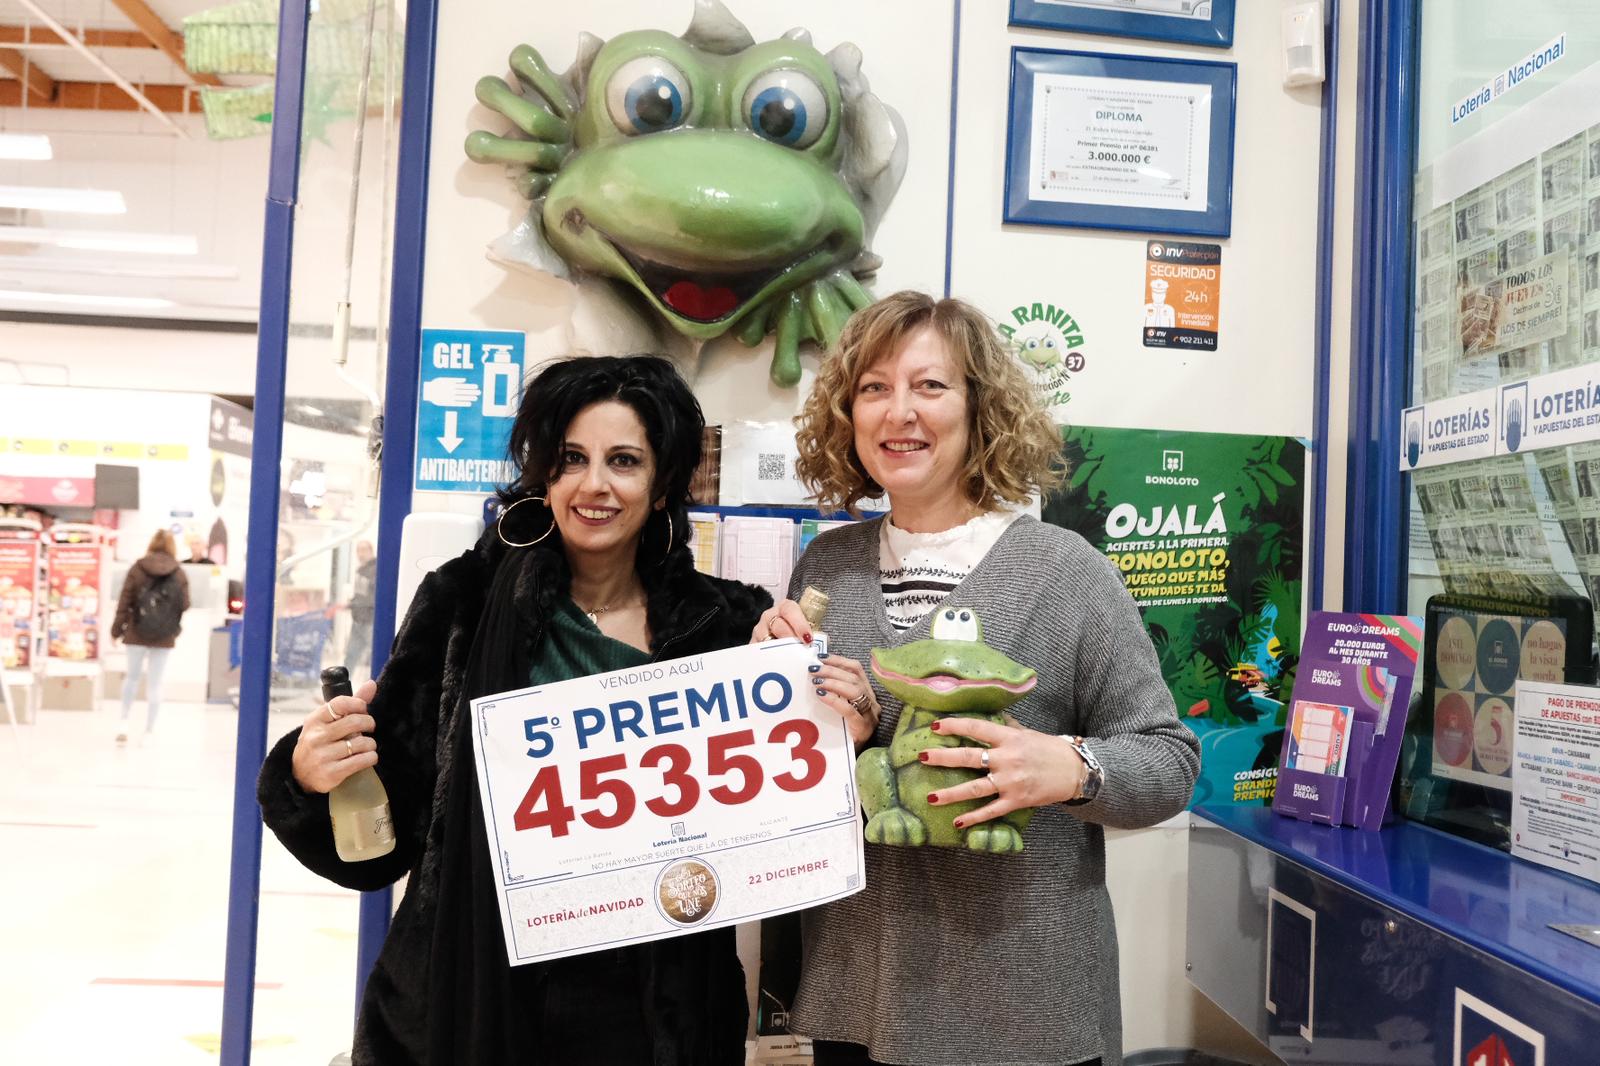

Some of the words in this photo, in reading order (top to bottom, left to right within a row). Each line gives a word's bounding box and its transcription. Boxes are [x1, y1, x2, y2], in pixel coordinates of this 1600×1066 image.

[1452, 87, 1491, 123] Lotería
[1508, 36, 1565, 88] Nacional
[1096, 111, 1143, 122] DIPLOMA
[1088, 151, 1141, 163] 3.000.000
[1144, 155, 1152, 164] €
[1150, 264, 1216, 280] SEGURIDAD
[1506, 269, 1536, 289] TODOS
[1538, 262, 1553, 279] LOS
[1184, 290, 1208, 303] 24h
[1505, 284, 1544, 306] JUEVES
[998, 322, 1016, 340] A
[1011, 303, 1084, 349] RANITA
[1180, 336, 1192, 344] 902
[433, 342, 474, 369] GEL
[1067, 357, 1083, 369] 37
[1533, 380, 1600, 420] LOTERÍA
[1428, 407, 1490, 439] LOTERÍAS
[1538, 419, 1571, 434] APUESTAS
[1572, 417, 1585, 428] DEL
[1587, 413, 1600, 425] ESTA
[1431, 440, 1457, 452] APUESTAS
[1457, 438, 1467, 448] DEL
[1467, 433, 1490, 445] ESTADO
[1145, 476, 1199, 486] BONOLOTO
[1105, 491, 1227, 538] OJALÁ
[1105, 541, 1156, 552] ACIERTES
[1157, 541, 1165, 550] A
[1166, 540, 1179, 549] LA
[1180, 537, 1230, 548] PRIMERA.
[1125, 573, 1166, 585] JUEGO
[1167, 571, 1196, 583] QUE
[1197, 566, 1226, 581] MÁS
[1128, 585, 1194, 597] RTUNIDADES
[1196, 585, 1210, 594] TE
[1211, 583, 1228, 593] DA.
[1163, 598, 1186, 606] LUNES
[1327, 622, 1353, 633] EURO
[1361, 625, 1400, 636] DREAMS
[1334, 639, 1361, 648] 20.000
[1362, 641, 1386, 650] EUROS
[1339, 648, 1354, 656] MES
[1355, 650, 1389, 659] DURANTE
[1341, 656, 1351, 664] 30
[1351, 655, 1372, 665] AÑOS
[600, 668, 663, 690] VENDIDO
[669, 657, 704, 679] AQUÍ
[1312, 669, 1333, 677] EURO
[1311, 676, 1342, 686] DREAMS
[1566, 700, 1574, 708] DE
[524, 716, 561, 759] 5º
[573, 671, 793, 749] PREMIO
[1541, 709, 1549, 717] DE
[1550, 711, 1580, 722] APUESTAS
[513, 719, 827, 838] 45353
[1234, 768, 1278, 781] CONSIGU
[1233, 778, 1276, 792] GRAND
[1294, 783, 1310, 792] EURO
[1233, 789, 1276, 801] PREMIO
[1292, 791, 1319, 801] DREAMS
[679, 832, 707, 843] Nacional
[605, 859, 622, 868] HAY
[624, 853, 654, 864] MAYOR
[655, 847, 685, 859] SUERTE
[687, 844, 704, 853] QUE
[705, 841, 716, 849] LA
[718, 838, 728, 847] DE
[731, 830, 773, 842] TENERNOS
[748, 875, 762, 885] 22
[766, 859, 829, 881] DICIEMBRE
[527, 909, 576, 928] LOTERÍA
[577, 908, 589, 918] de
[589, 897, 644, 916] NAVIDAD
